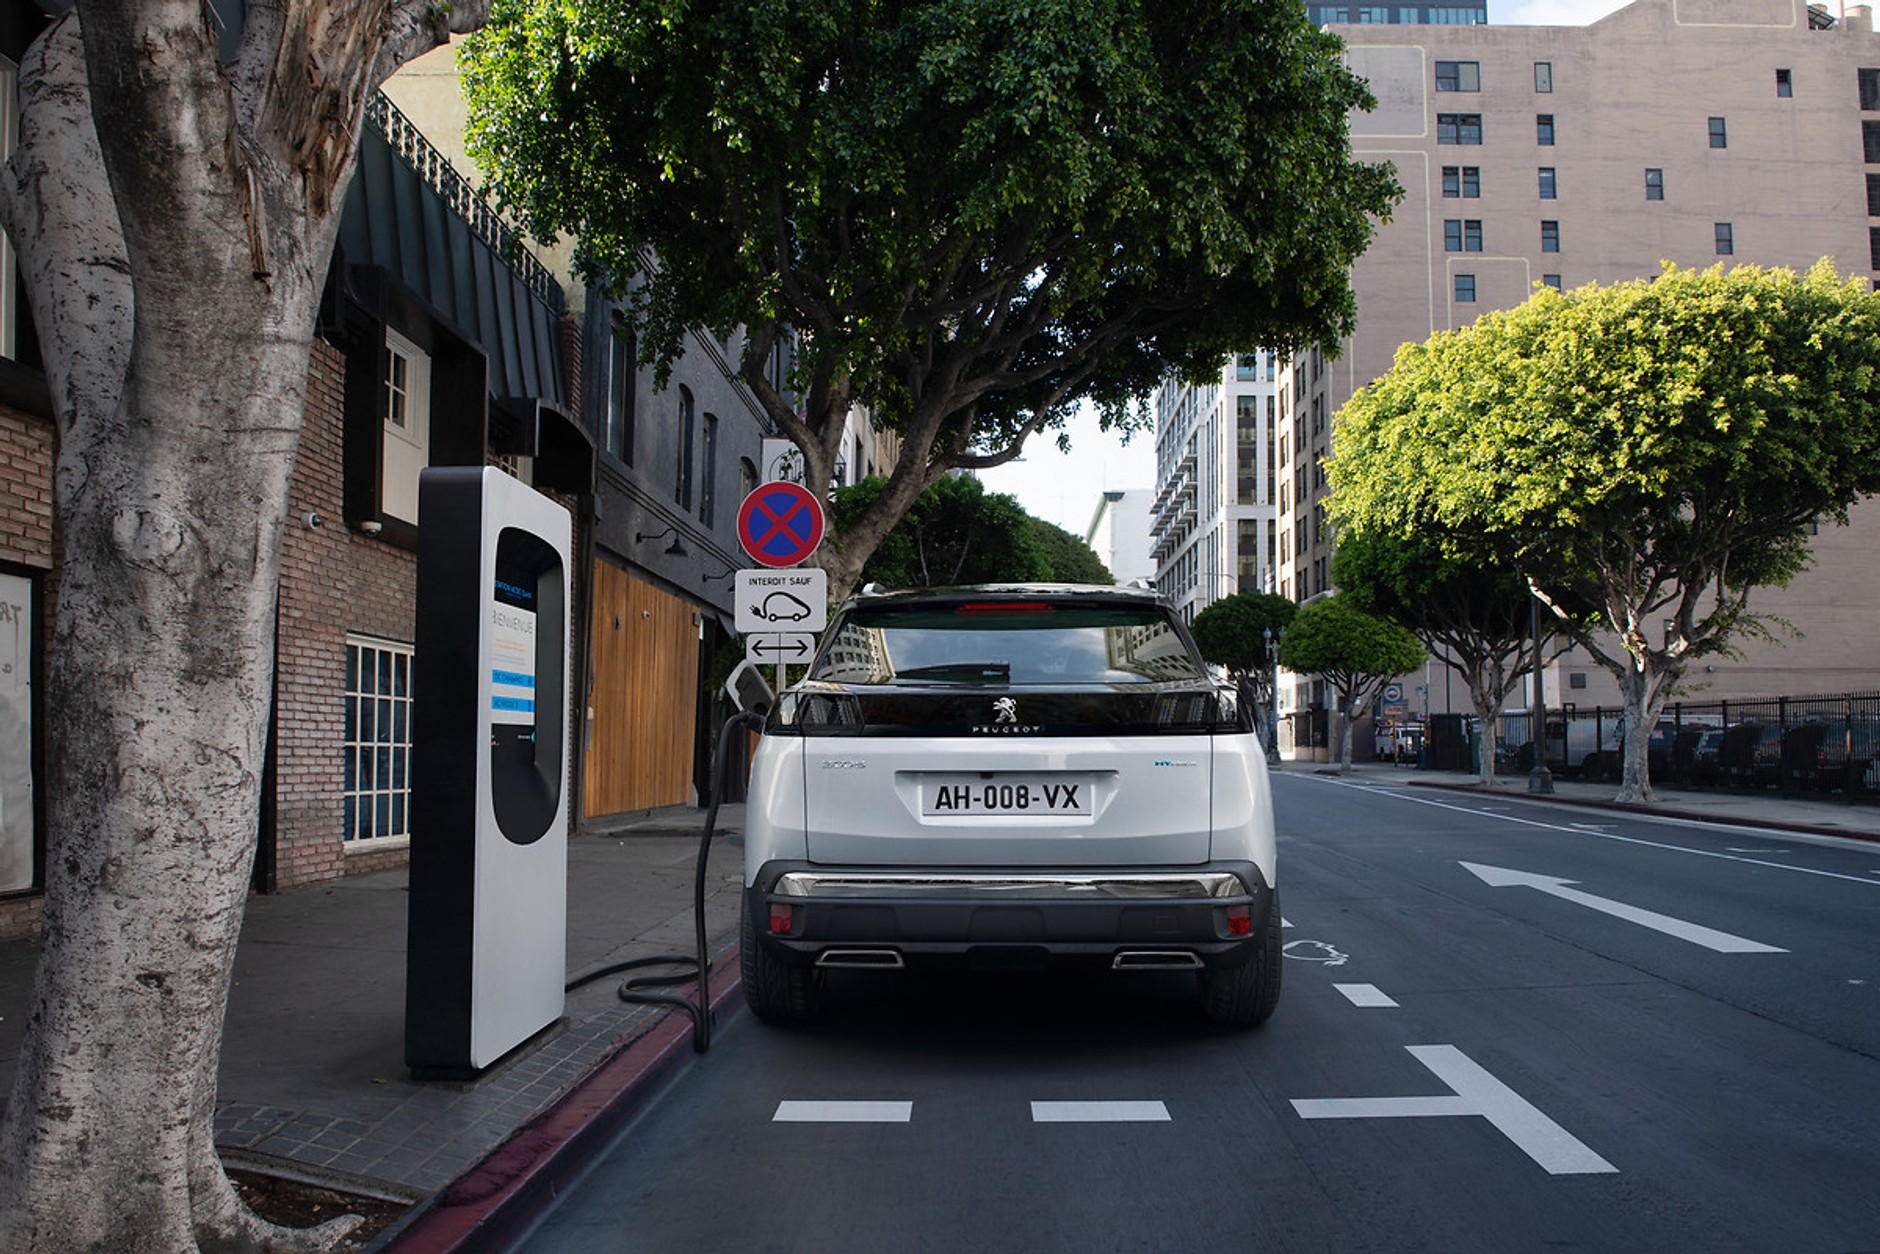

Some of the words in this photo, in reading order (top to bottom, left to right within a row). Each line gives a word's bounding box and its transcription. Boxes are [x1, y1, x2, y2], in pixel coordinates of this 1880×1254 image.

[749, 577, 786, 586] INTERDIT
[789, 577, 812, 586] SAUF
[972, 725, 1040, 733] PEUGEOT
[935, 784, 1079, 810] AH-008-VX
